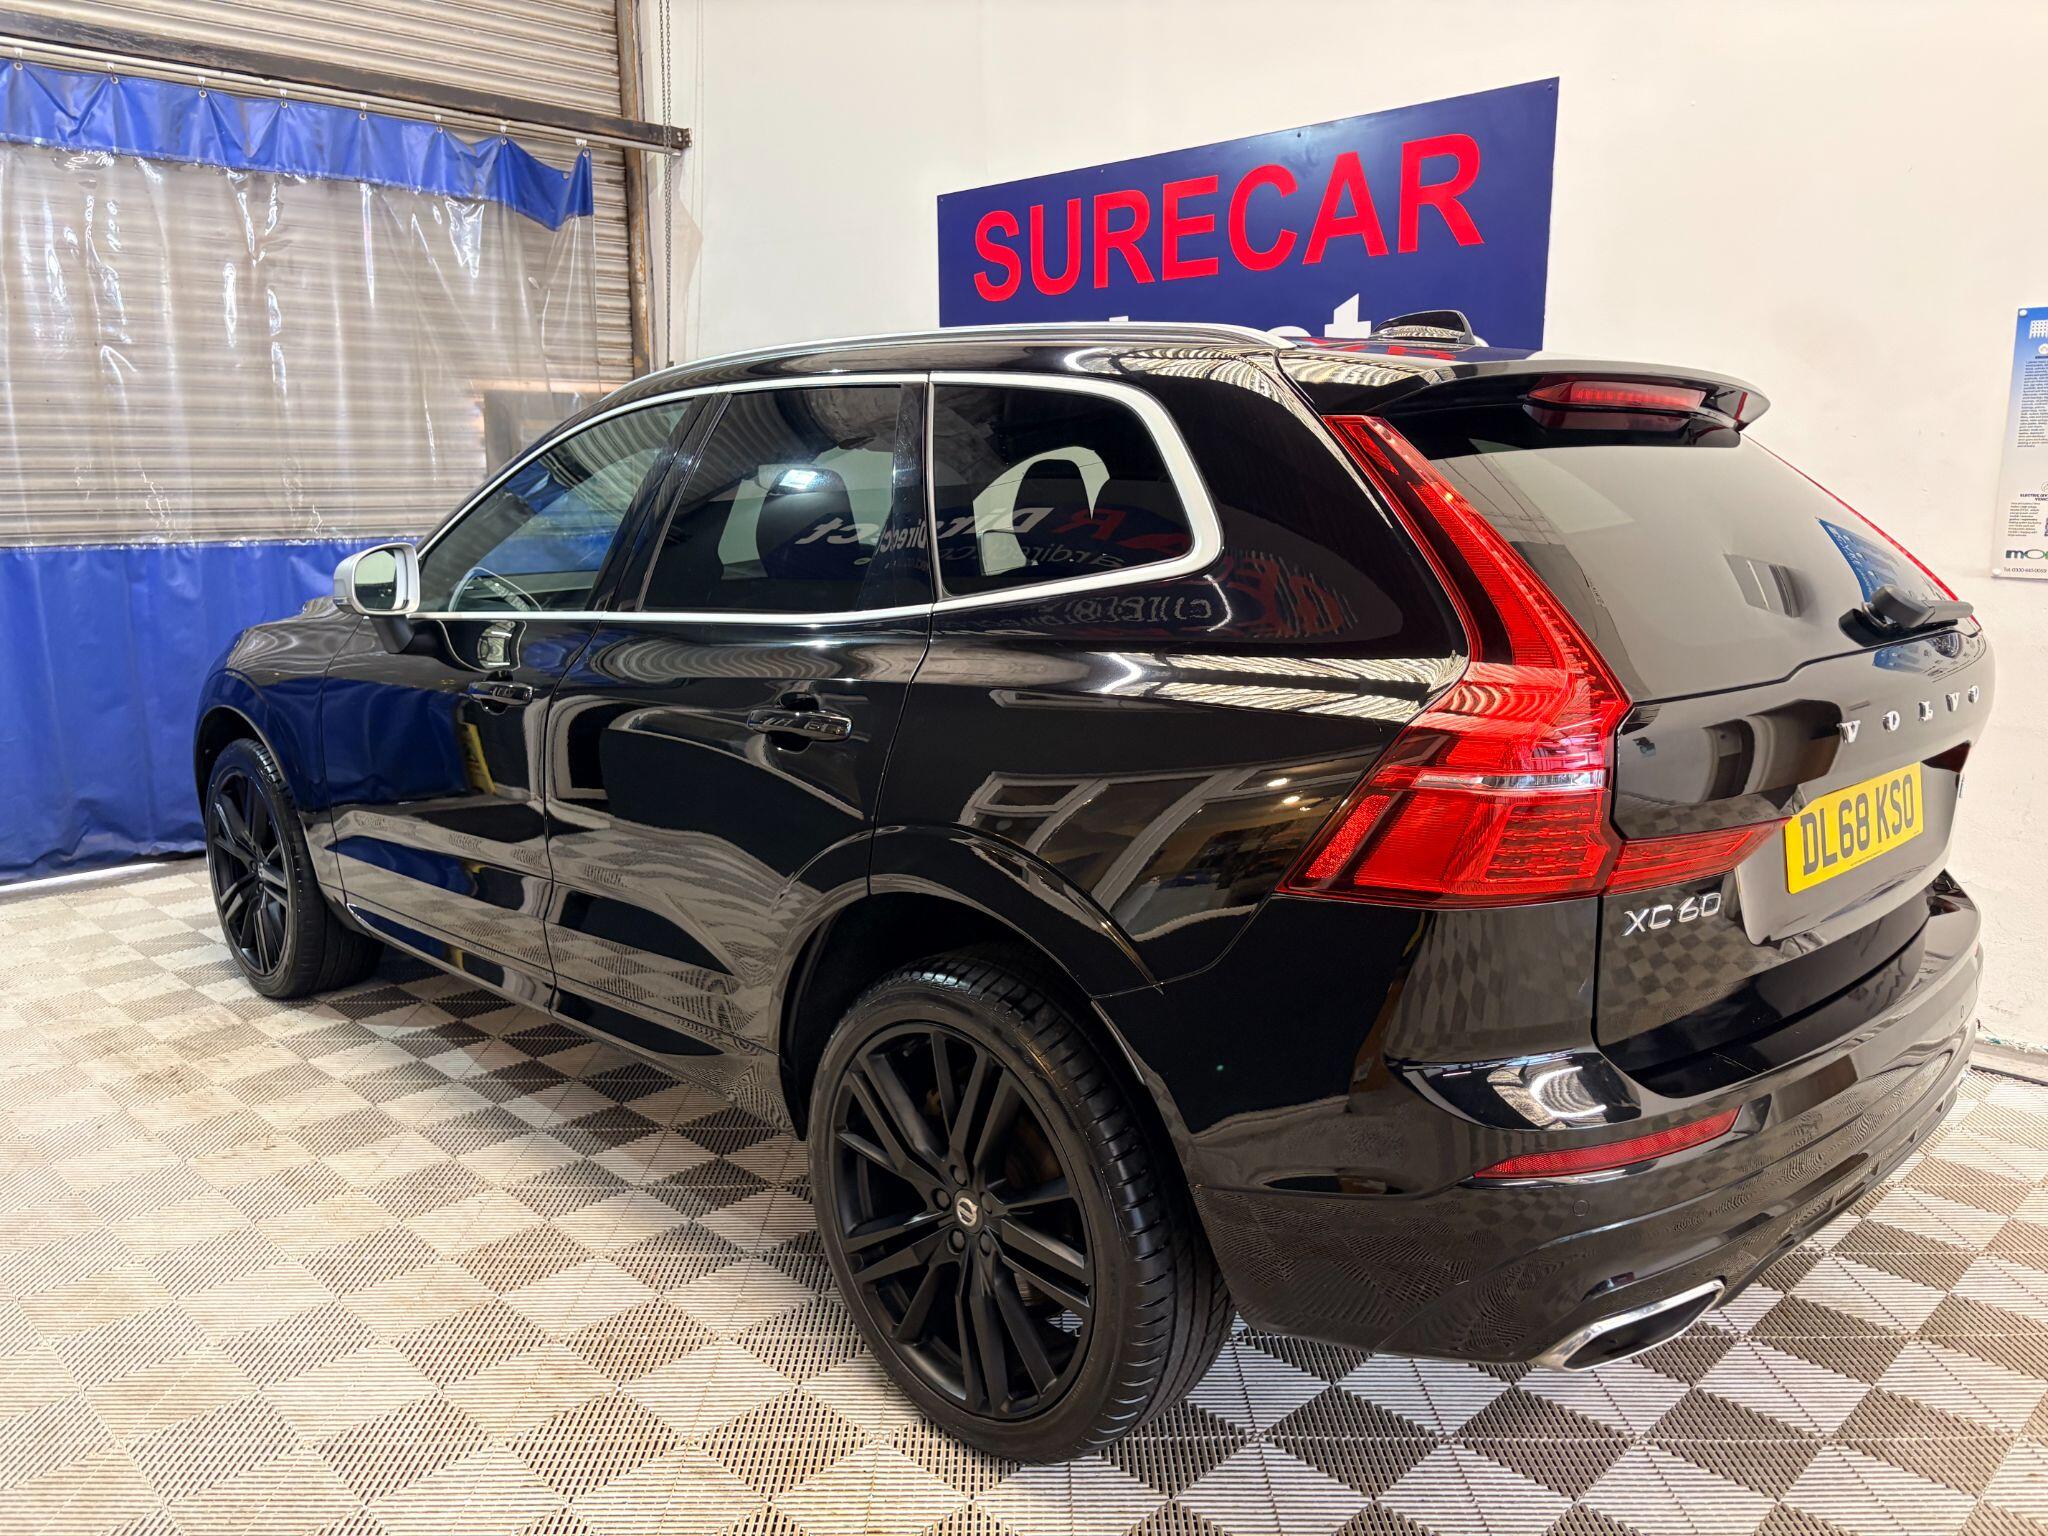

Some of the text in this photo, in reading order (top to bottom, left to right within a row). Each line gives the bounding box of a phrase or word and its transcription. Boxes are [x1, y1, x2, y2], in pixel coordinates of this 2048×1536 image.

[973, 133, 1486, 302] SURECAR
[1836, 684, 1980, 744] VOLVO
[1800, 774, 1915, 876] DL68 KSO
[1621, 892, 1721, 937] XC60
